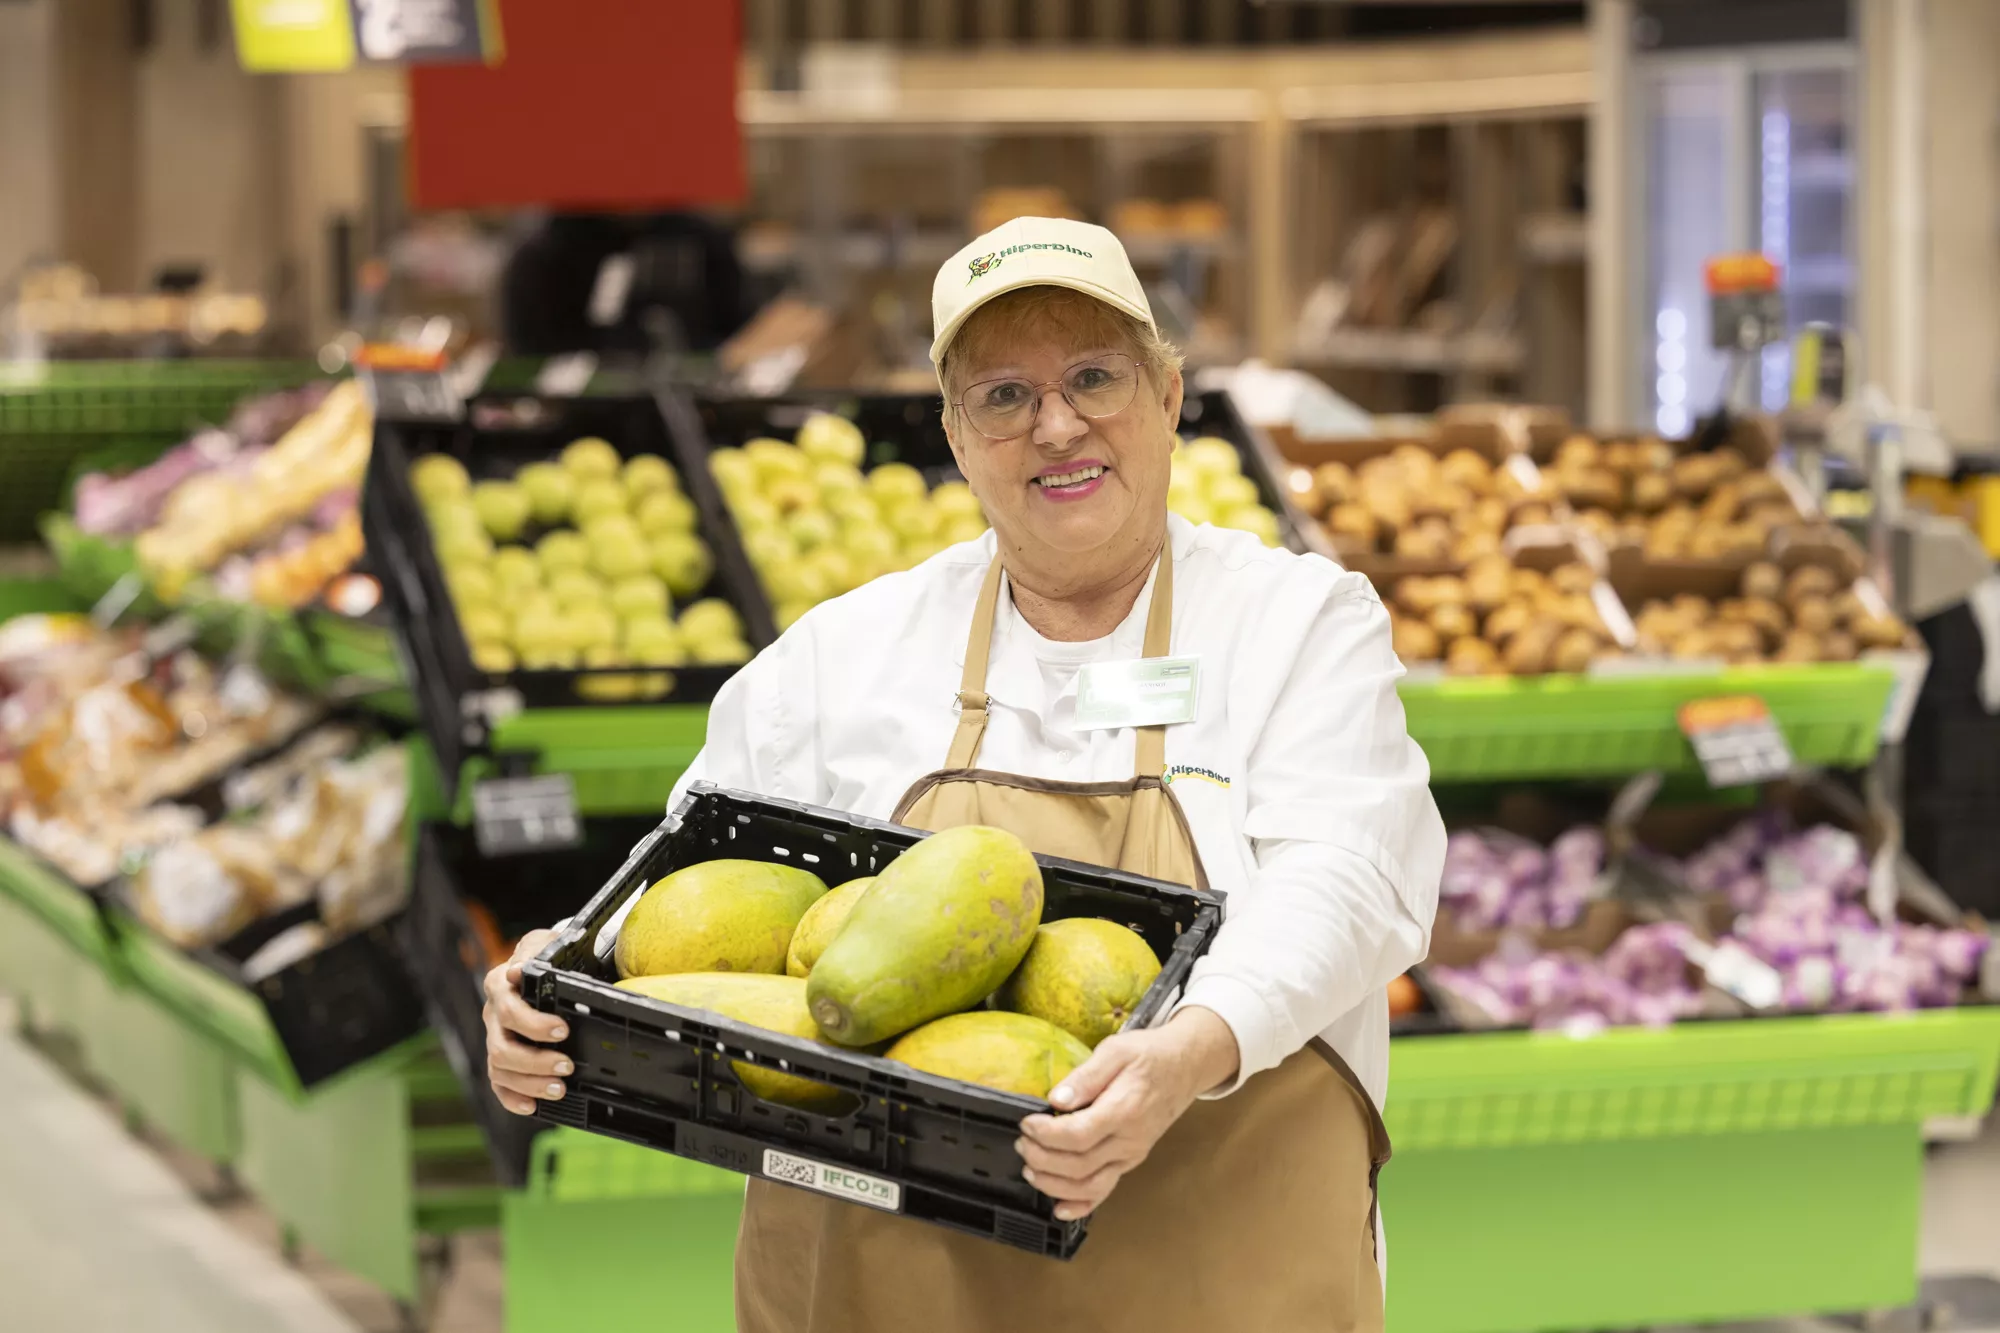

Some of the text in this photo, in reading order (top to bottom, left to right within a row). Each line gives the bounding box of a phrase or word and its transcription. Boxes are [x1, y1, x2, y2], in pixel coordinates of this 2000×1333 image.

[999, 242, 1093, 259] HiperDino
[1171, 764, 1231, 783] HiperDino
[823, 1168, 870, 1192] IFCO
